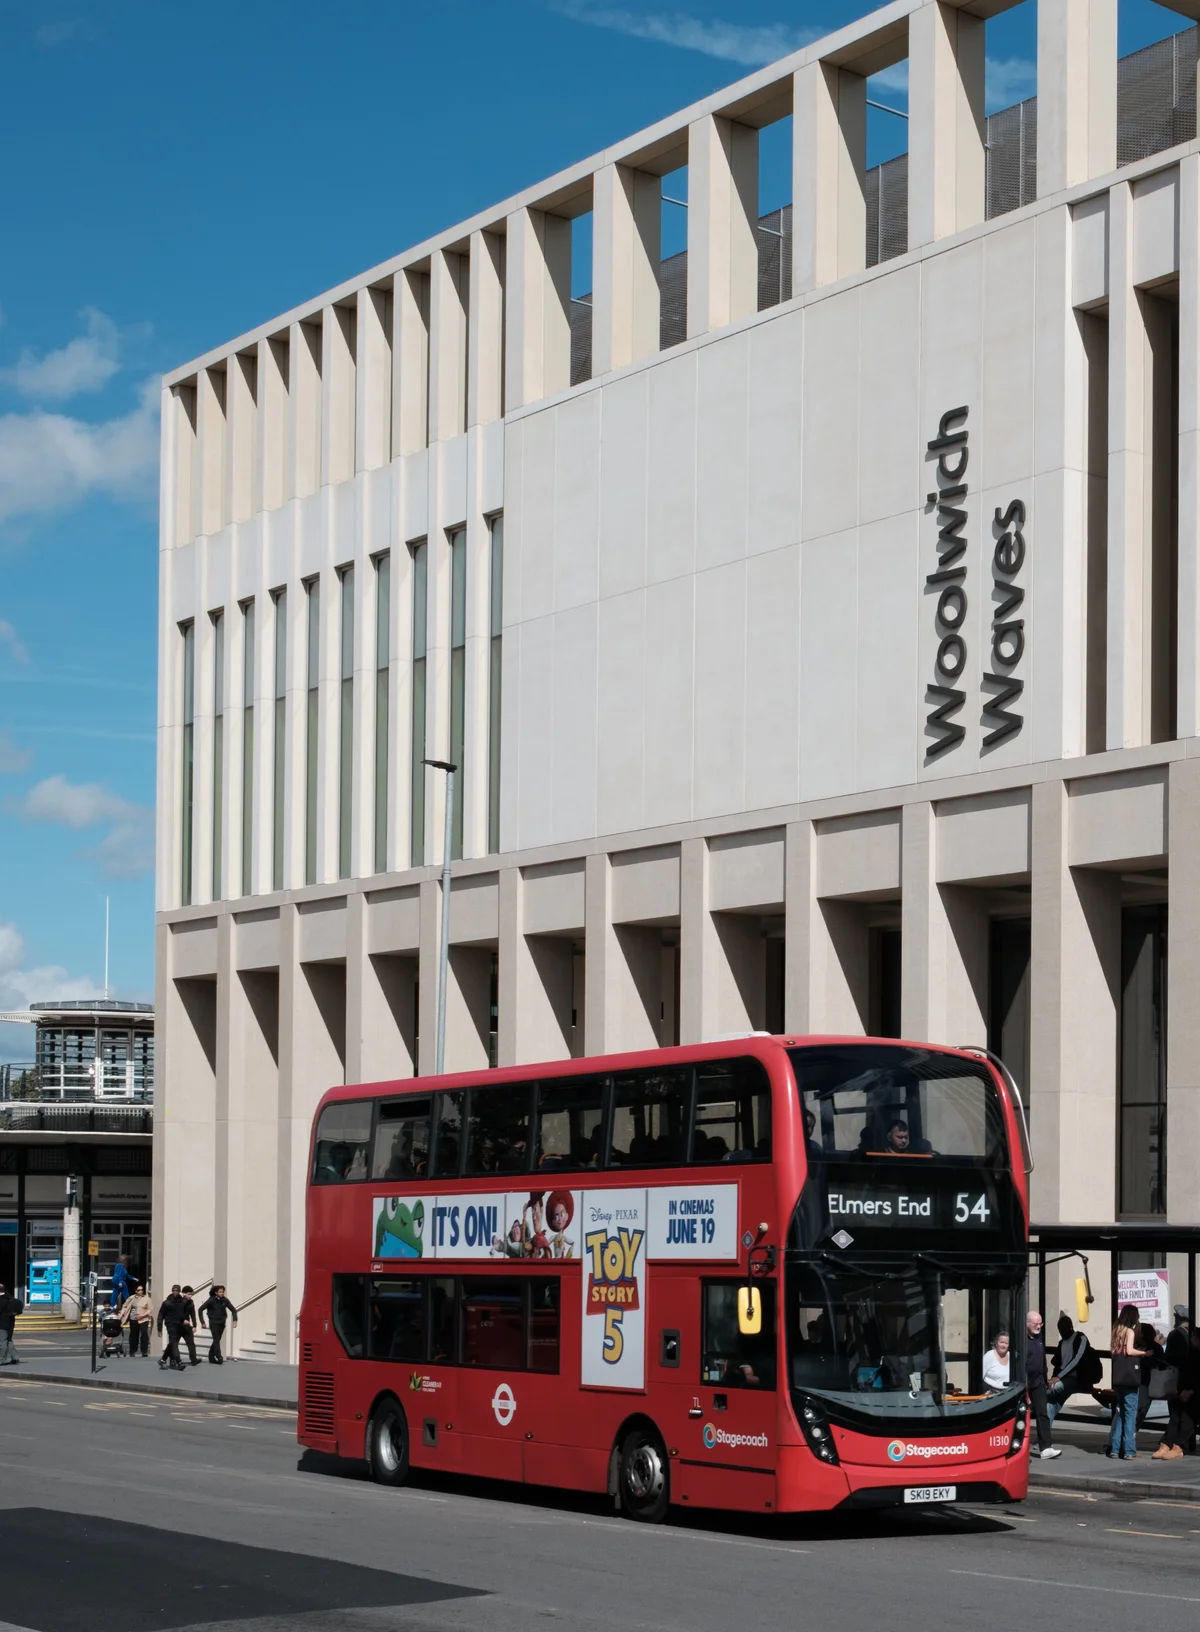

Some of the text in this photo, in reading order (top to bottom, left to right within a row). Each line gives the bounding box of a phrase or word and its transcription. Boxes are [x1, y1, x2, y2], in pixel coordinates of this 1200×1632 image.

[926, 405, 968, 757] Woolwich
[982, 499, 1025, 746] Waves
[669, 1199, 715, 1215] IN CINEMAS
[828, 1193, 930, 1216] Elmers End
[954, 1192, 990, 1223] 54
[589, 1206, 639, 1225] Disney PIXAR
[431, 1205, 498, 1247] IT'S ON!
[666, 1217, 715, 1244] JUNE 19
[585, 1226, 645, 1285] TOY
[1140, 1280, 1146, 1288] TO
[1147, 1279, 1158, 1288] YOUR
[592, 1286, 634, 1303] STORY
[1129, 1290, 1144, 1299] FAMILY
[602, 1304, 624, 1365] 5
[716, 1428, 768, 1448] Stagecoach
[989, 1435, 1010, 1447] 11310
[906, 1443, 969, 1458] Stagecoach
[910, 1488, 951, 1501] SK19 EKY
